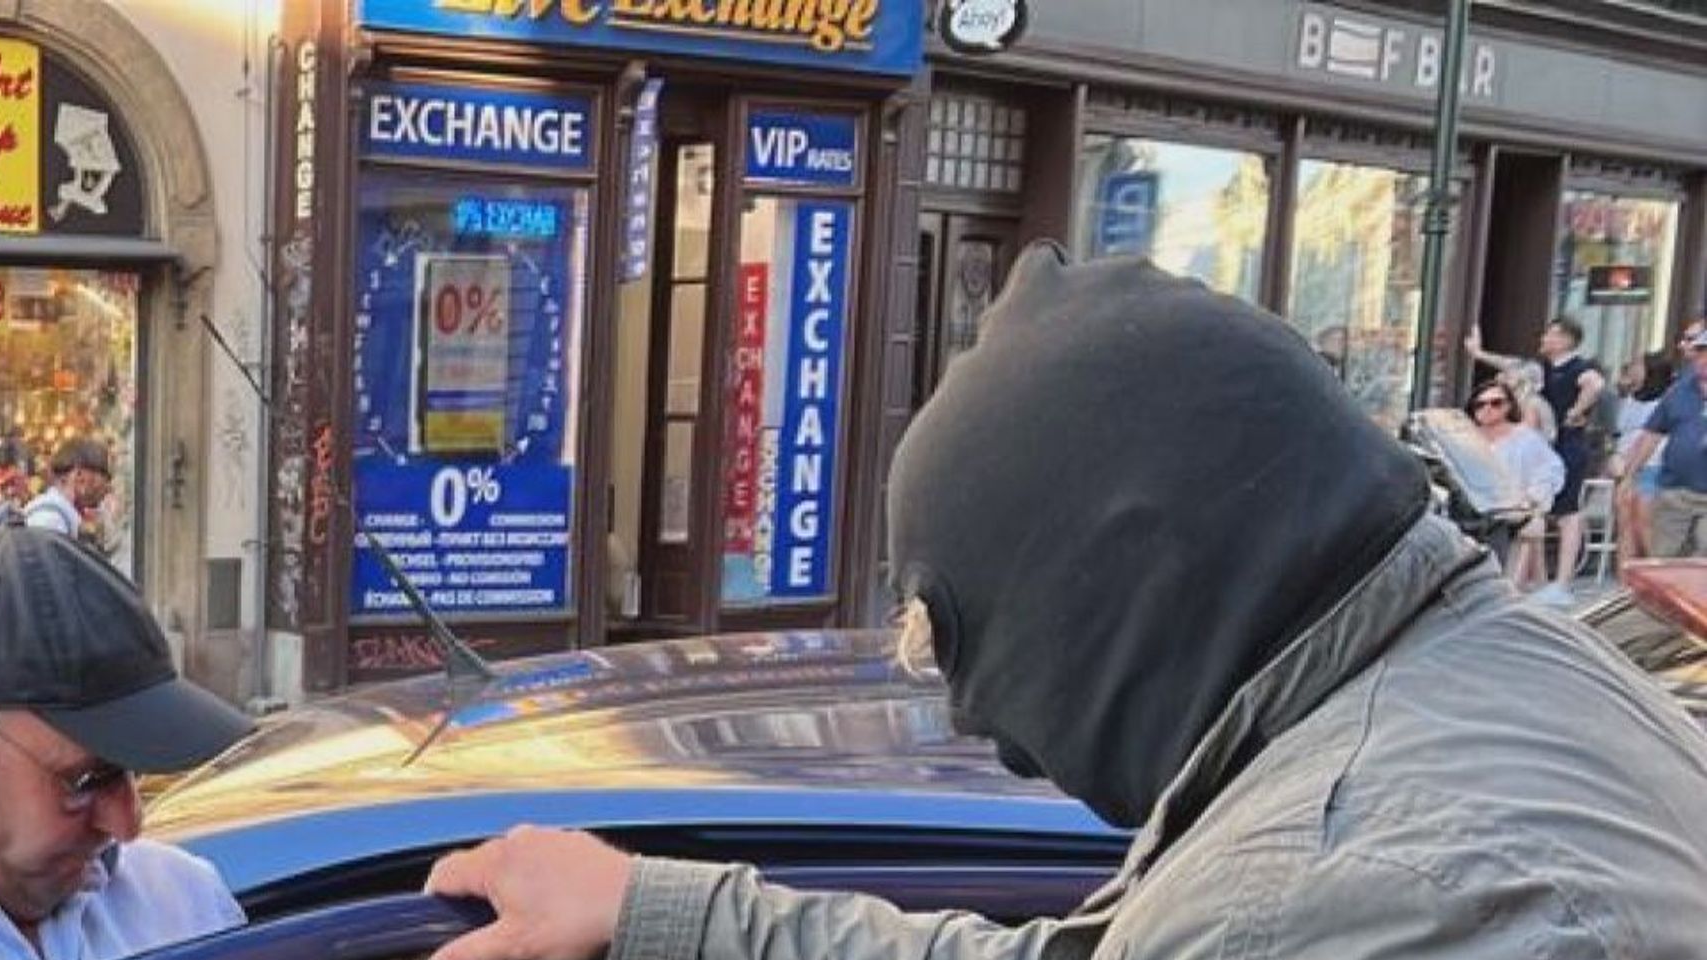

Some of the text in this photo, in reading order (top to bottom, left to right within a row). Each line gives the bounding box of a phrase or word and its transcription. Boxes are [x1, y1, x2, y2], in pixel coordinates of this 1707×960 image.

[1415, 36, 1494, 95] BR
[370, 95, 583, 154] EXCHANGE
[751, 126, 809, 168] VIP
[436, 284, 502, 336] 0%
[733, 275, 763, 506] EXCHANGE
[789, 211, 836, 587] EXCHANGE
[430, 467, 502, 528] 0%
